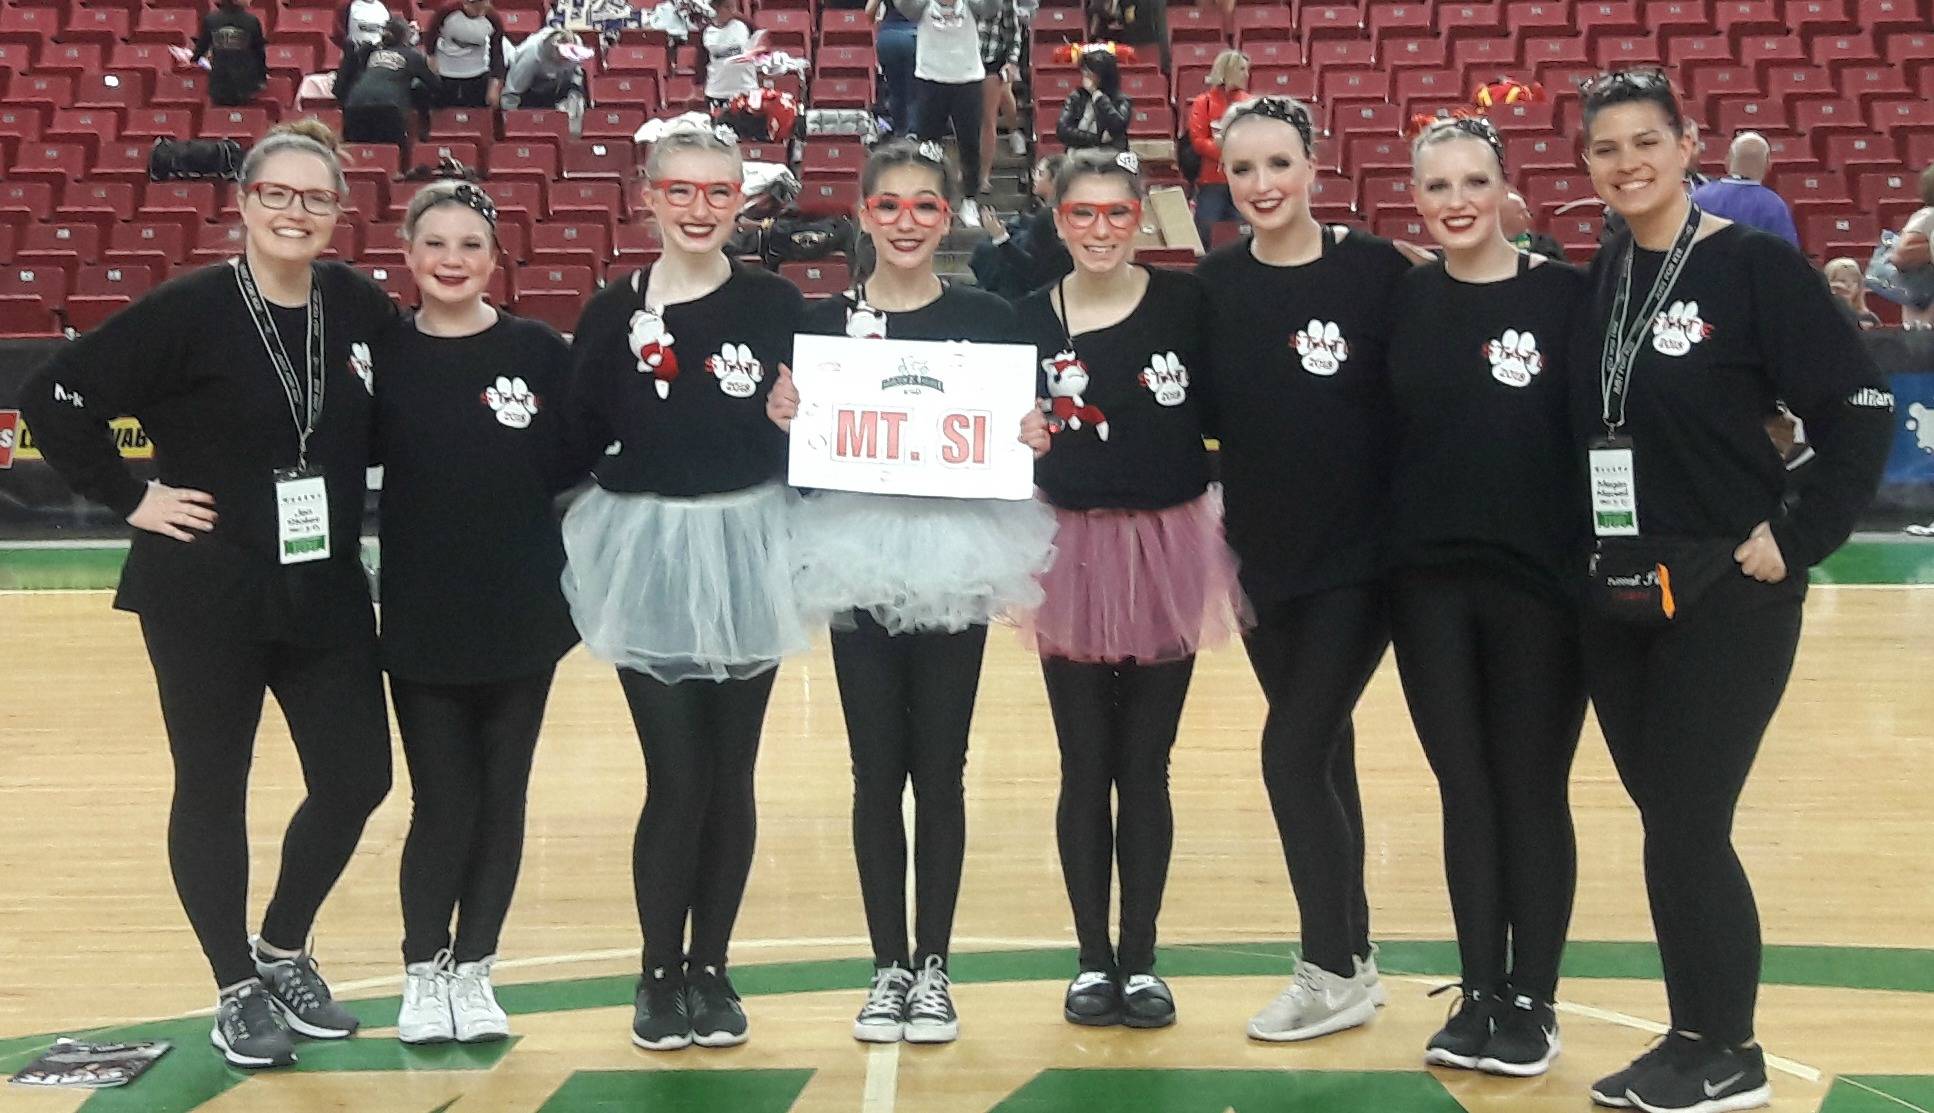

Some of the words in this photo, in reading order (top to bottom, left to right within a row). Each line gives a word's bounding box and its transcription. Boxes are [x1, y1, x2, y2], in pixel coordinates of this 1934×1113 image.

[1309, 357, 1334, 370] 2018
[1499, 367, 1526, 382] 2018
[1844, 386, 1895, 413] ilitary
[503, 411, 527, 423] 2018
[836, 409, 921, 462] MT.
[941, 413, 987, 465] SI
